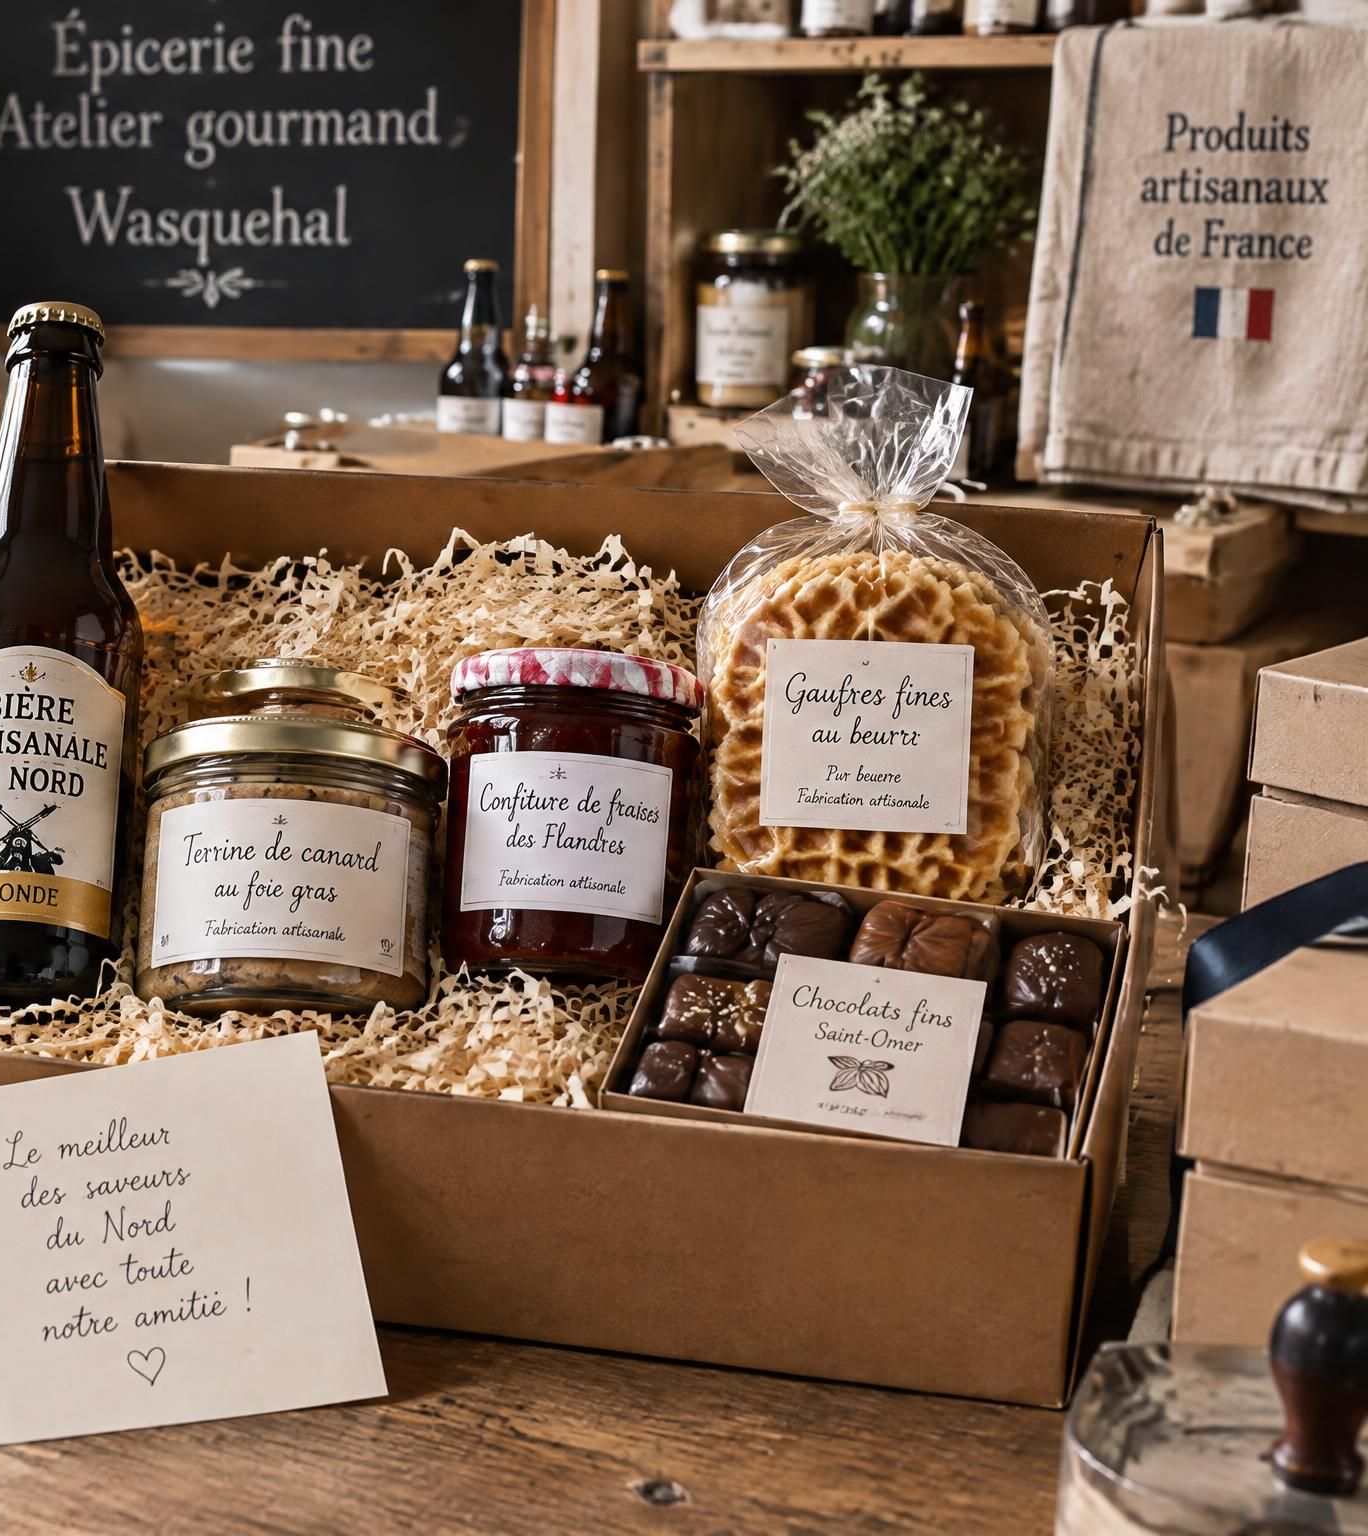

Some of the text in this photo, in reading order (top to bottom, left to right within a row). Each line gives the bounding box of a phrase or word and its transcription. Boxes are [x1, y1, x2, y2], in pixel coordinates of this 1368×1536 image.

[52, 8, 375, 94] Épicerie fine
[185, 86, 442, 168] gourmand
[1164, 110, 1311, 152] Produits
[1140, 167, 1329, 204] artisanaux
[66, 186, 352, 267] Wasquehal
[1153, 218, 1313, 260] de France
[785, 671, 953, 720] Gaufres fines
[811, 728, 842, 745] au
[8, 766, 85, 798] NORD
[825, 764, 851, 783] Pur
[479, 782, 570, 822] Confiture
[577, 785, 602, 813] de
[796, 787, 864, 807] Fabrication
[183, 830, 382, 873] Terrine de canard
[505, 822, 626, 855] des Flandres
[214, 870, 338, 913] au foie gras
[498, 869, 565, 888] Fabrication
[204, 919, 277, 937] Fabrication
[792, 984, 953, 1033] Chocolats fins
[814, 1021, 924, 1053] Saint-Omer
[2, 1116, 172, 1170] Le meilleur
[21, 1167, 192, 1209] des saveurs
[46, 1199, 177, 1250] du Nord
[45, 1247, 195, 1295] avec toute
[41, 1304, 120, 1342] notre
[244, 1275, 253, 1313] !
